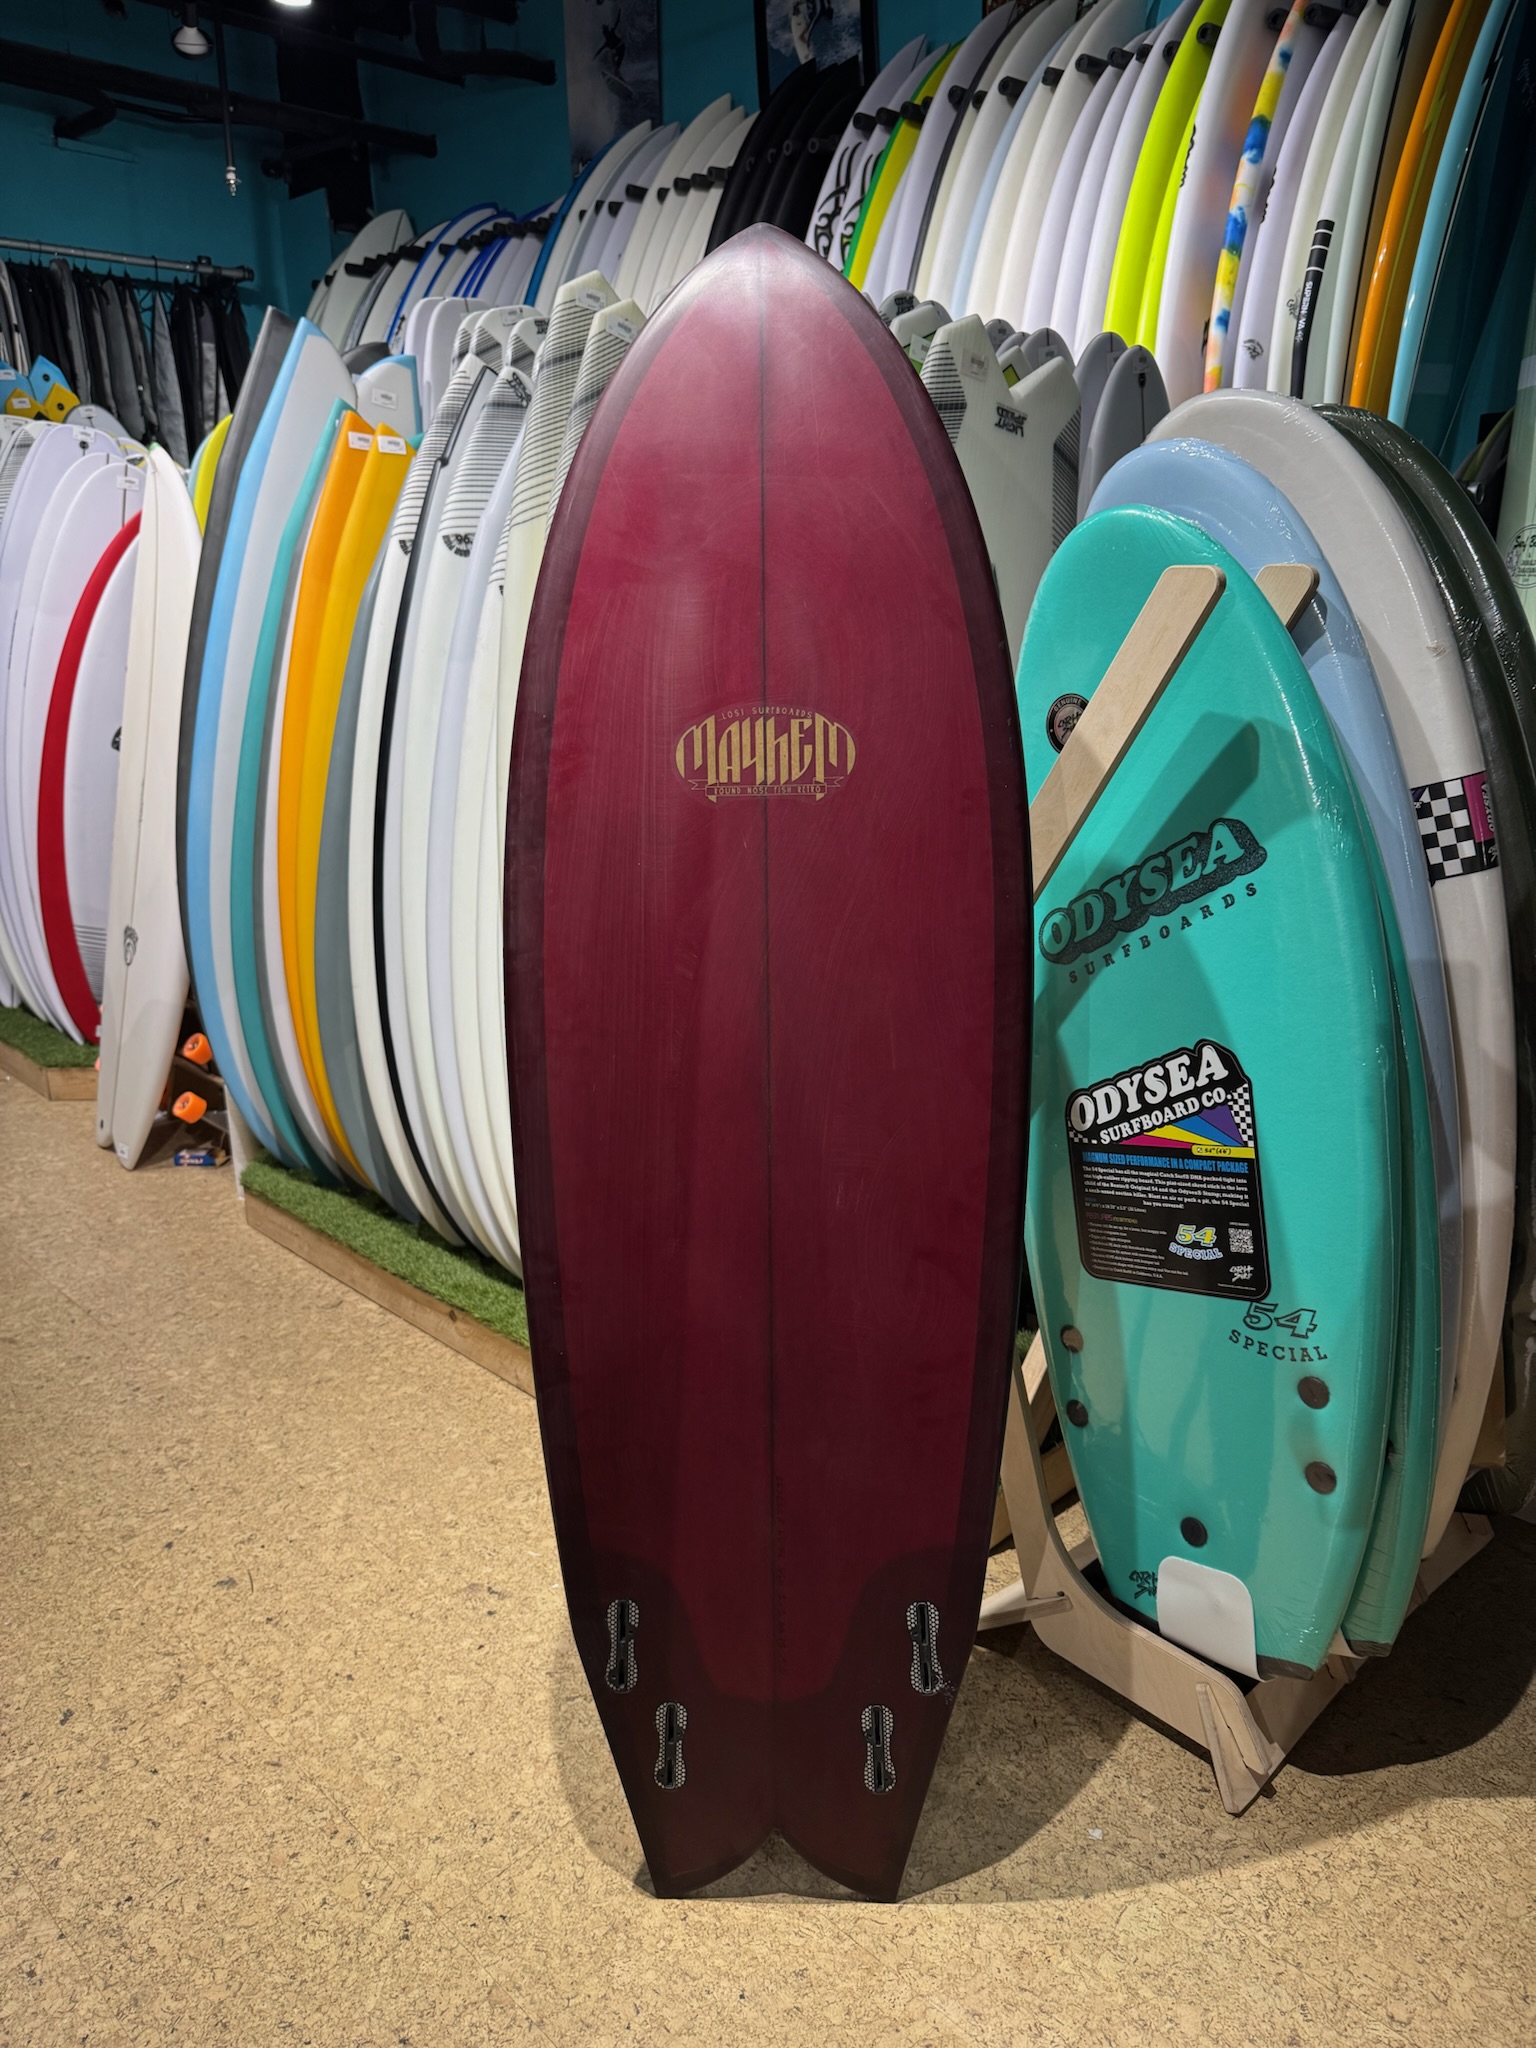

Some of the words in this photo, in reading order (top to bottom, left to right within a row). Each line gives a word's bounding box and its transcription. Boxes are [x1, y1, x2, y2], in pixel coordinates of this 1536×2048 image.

[751, 706, 813, 719] SURFBOARDS
[714, 786, 741, 795] ROUND
[747, 785, 768, 795] NOSE
[774, 785, 791, 794] FISH
[797, 784, 821, 794] RETRO
[1039, 818, 1260, 961] ODYSEA
[1068, 882, 1257, 984] SURFBOARDS
[1070, 1044, 1229, 1132] ODYSEA
[1100, 1096, 1200, 1145] SURFBOARD
[1201, 1087, 1232, 1108] CO.
[1109, 1153, 1126, 1165] SIZED
[1126, 1154, 1171, 1168] PERFORMANCE
[1171, 1158, 1180, 1169] IN
[1184, 1159, 1217, 1172] COMPACT
[1217, 1161, 1249, 1174] PACKAGE
[1168, 1242, 1224, 1260] SPECIAL
[1175, 1223, 1217, 1247] 54
[1242, 1301, 1318, 1340] 54
[1228, 1329, 1328, 1362] SPECIAL
